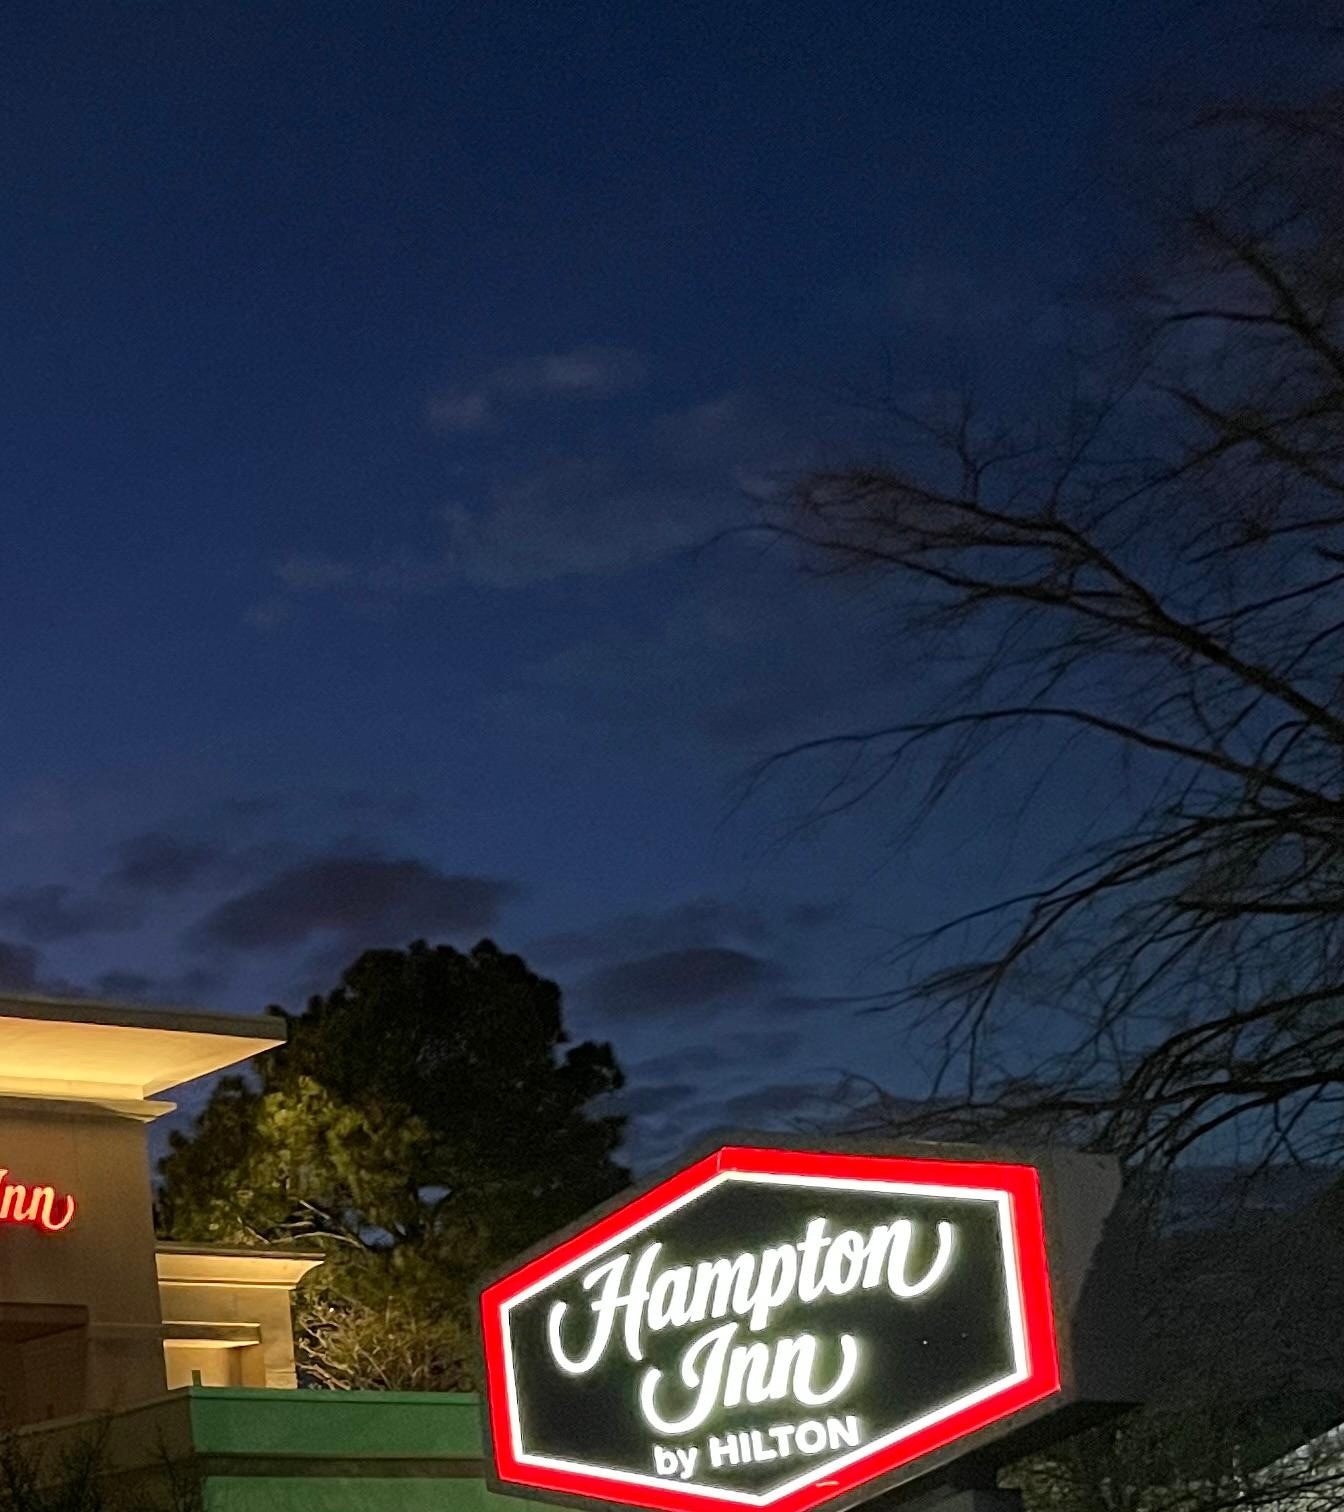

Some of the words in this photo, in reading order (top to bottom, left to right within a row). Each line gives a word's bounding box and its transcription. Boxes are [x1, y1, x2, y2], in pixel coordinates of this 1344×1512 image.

[548, 1216, 958, 1375] Hampton
[639, 1321, 860, 1436] Inn
[652, 1444, 698, 1480] by
[708, 1414, 860, 1468] HILTON
